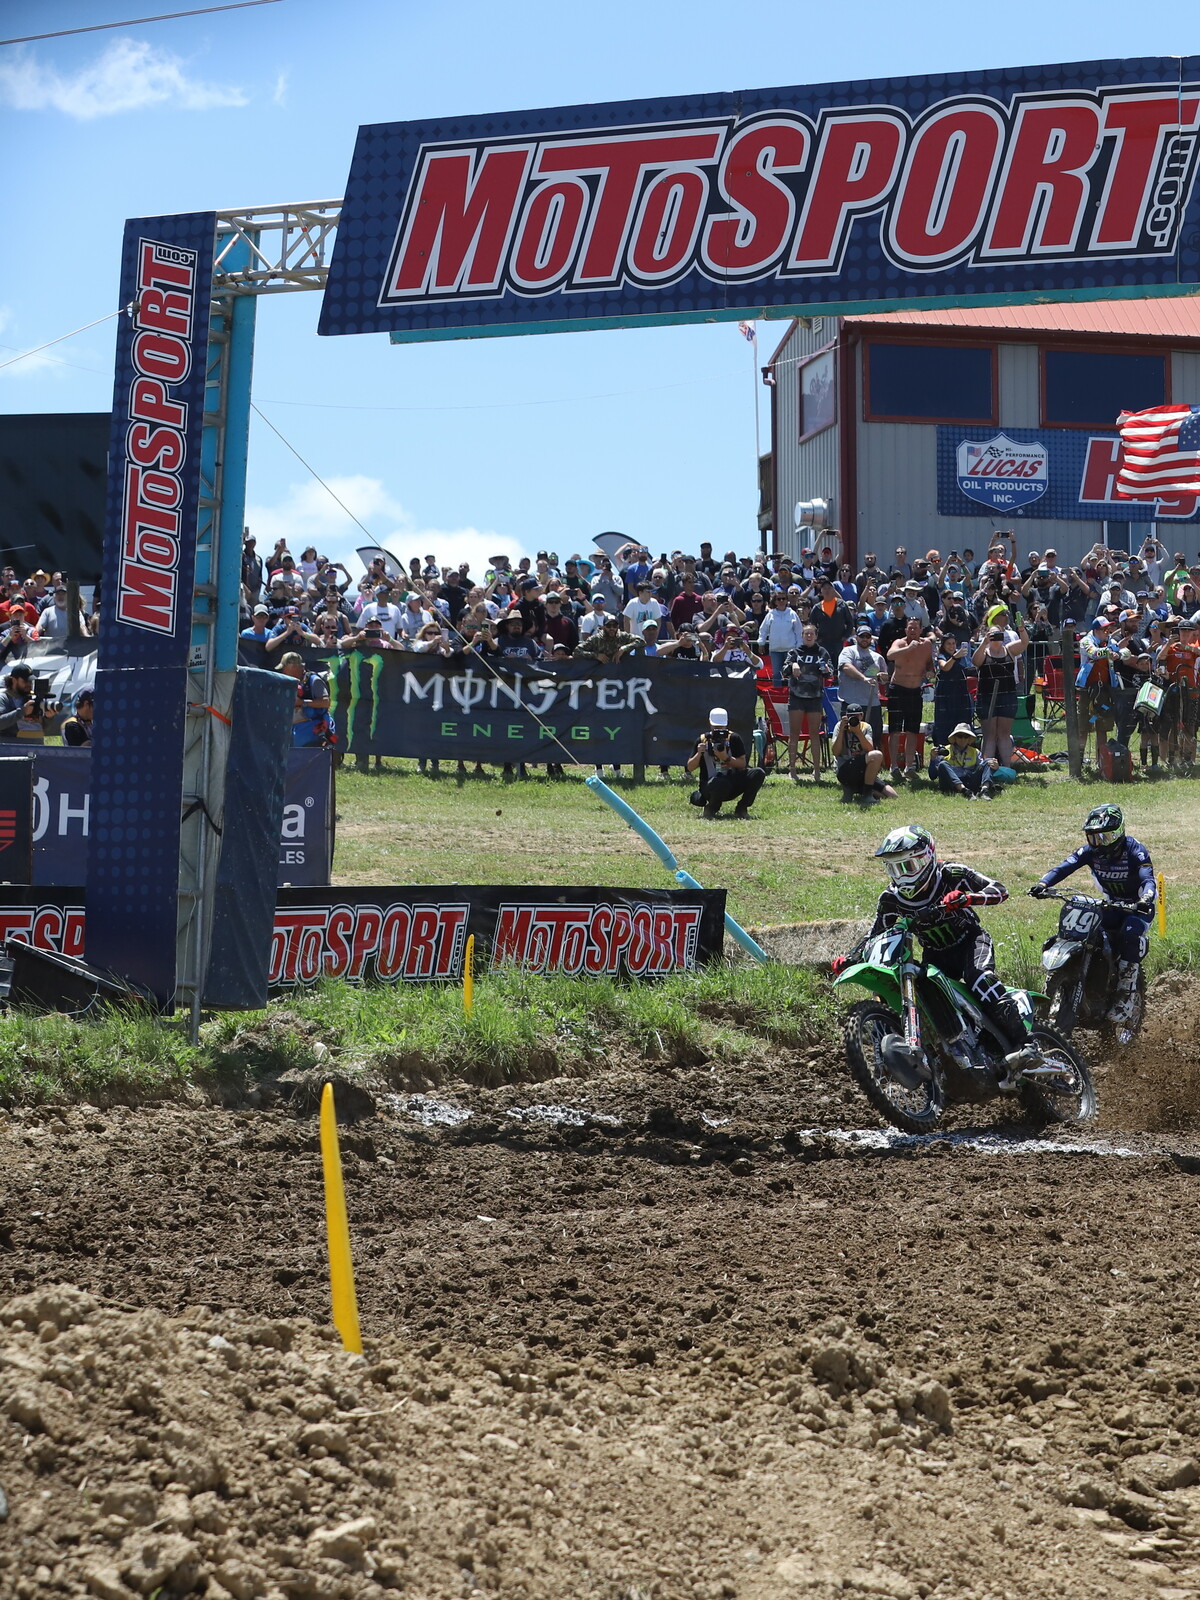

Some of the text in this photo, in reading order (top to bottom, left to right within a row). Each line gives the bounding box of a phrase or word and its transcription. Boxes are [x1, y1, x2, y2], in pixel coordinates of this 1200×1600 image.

[1147, 133, 1192, 248] .com
[967, 459, 1043, 477] LUCAS
[962, 480, 1044, 492] OIL PRODUCTS
[992, 494, 1016, 503] INC.
[402, 668, 658, 715] MONSTER
[440, 722, 621, 741] ENERGY
[1097, 870, 1129, 879] THOR
[1062, 909, 1100, 933] 49
[267, 903, 471, 986] OTOSPORT
[867, 933, 903, 965] 47
